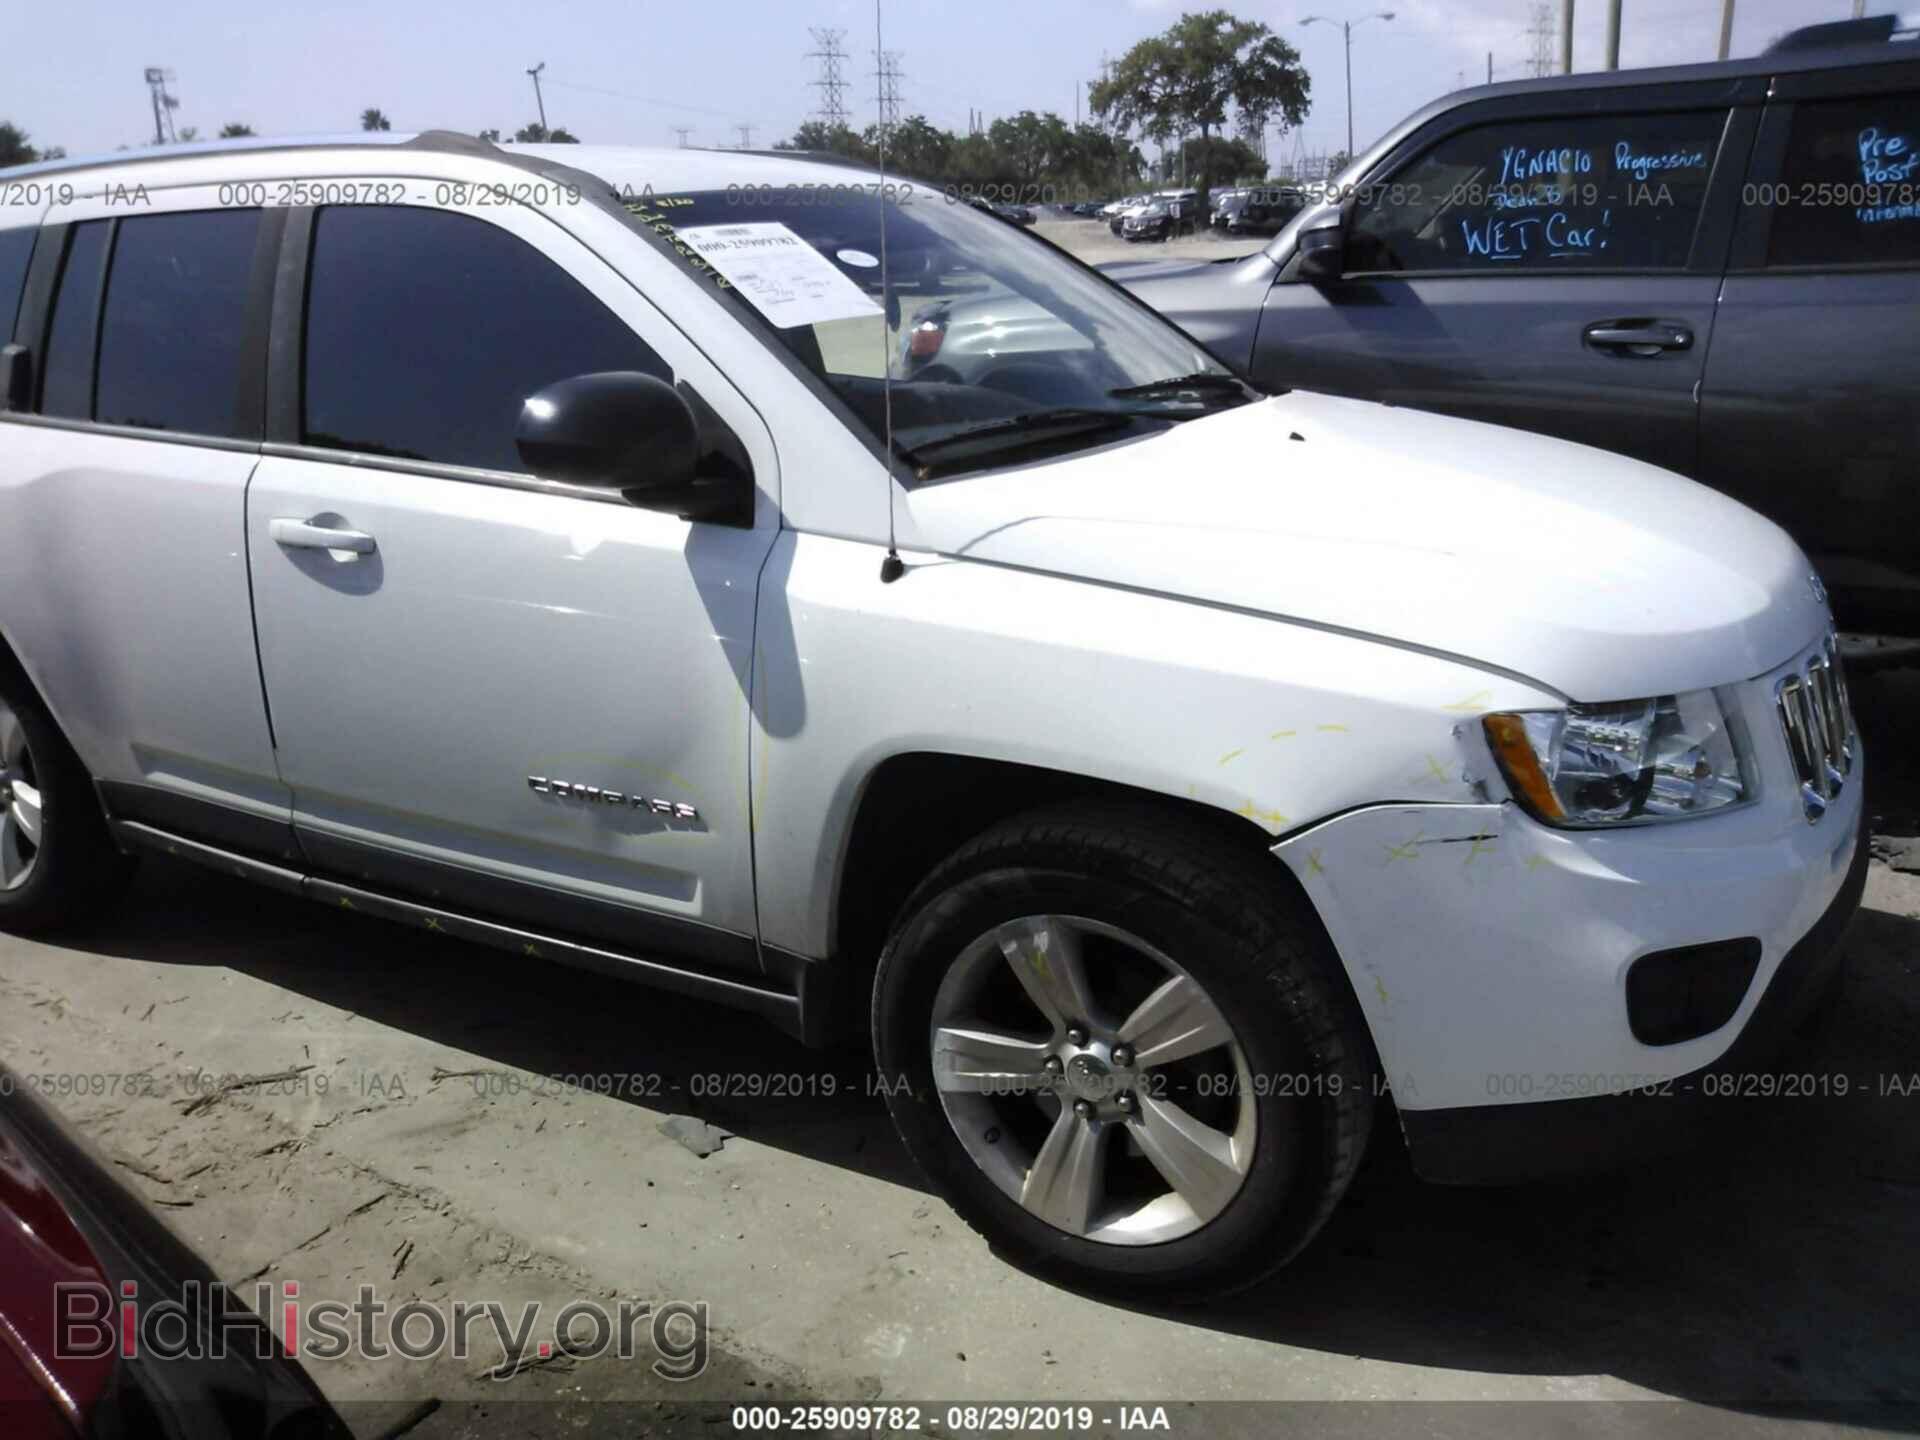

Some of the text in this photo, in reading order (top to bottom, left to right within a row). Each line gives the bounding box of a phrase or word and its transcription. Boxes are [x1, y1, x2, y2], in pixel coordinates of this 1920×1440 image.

[1615, 141, 1708, 180] Progressive
[1858, 128, 1907, 161] Pre
[1863, 154, 1919, 184] Post
[1462, 217, 1540, 254] WET
